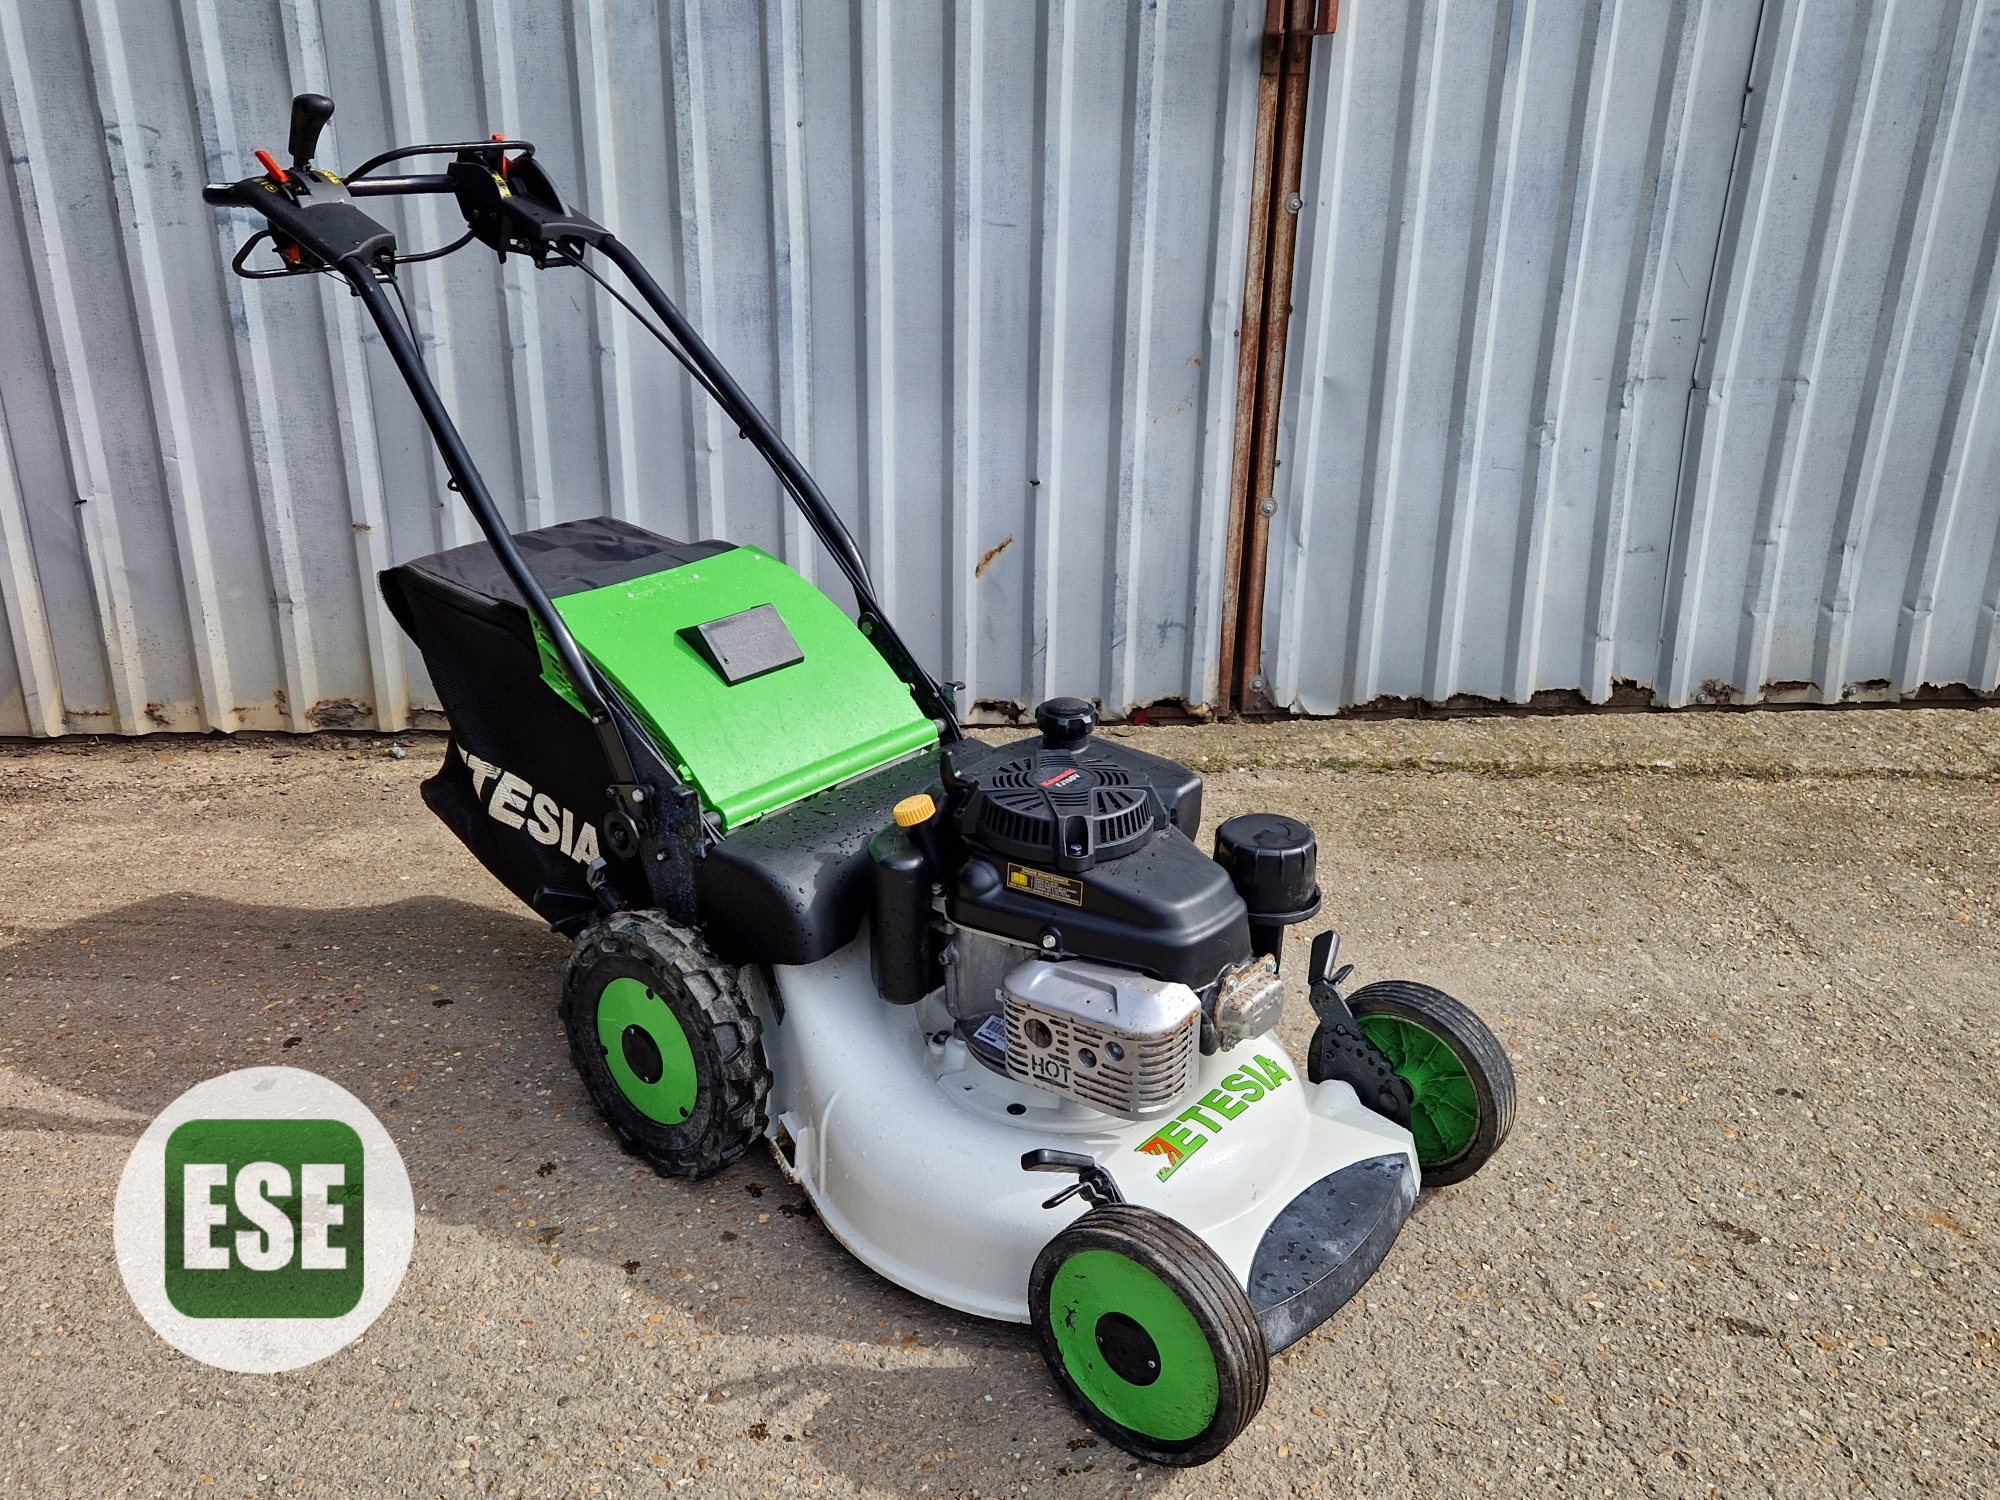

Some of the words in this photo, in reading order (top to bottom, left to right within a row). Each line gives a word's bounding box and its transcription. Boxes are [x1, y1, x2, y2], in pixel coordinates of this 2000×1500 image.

[457, 743, 601, 866] TESIA
[1031, 1054, 1072, 1083] HOT
[1157, 1054, 1293, 1166] ETESIA
